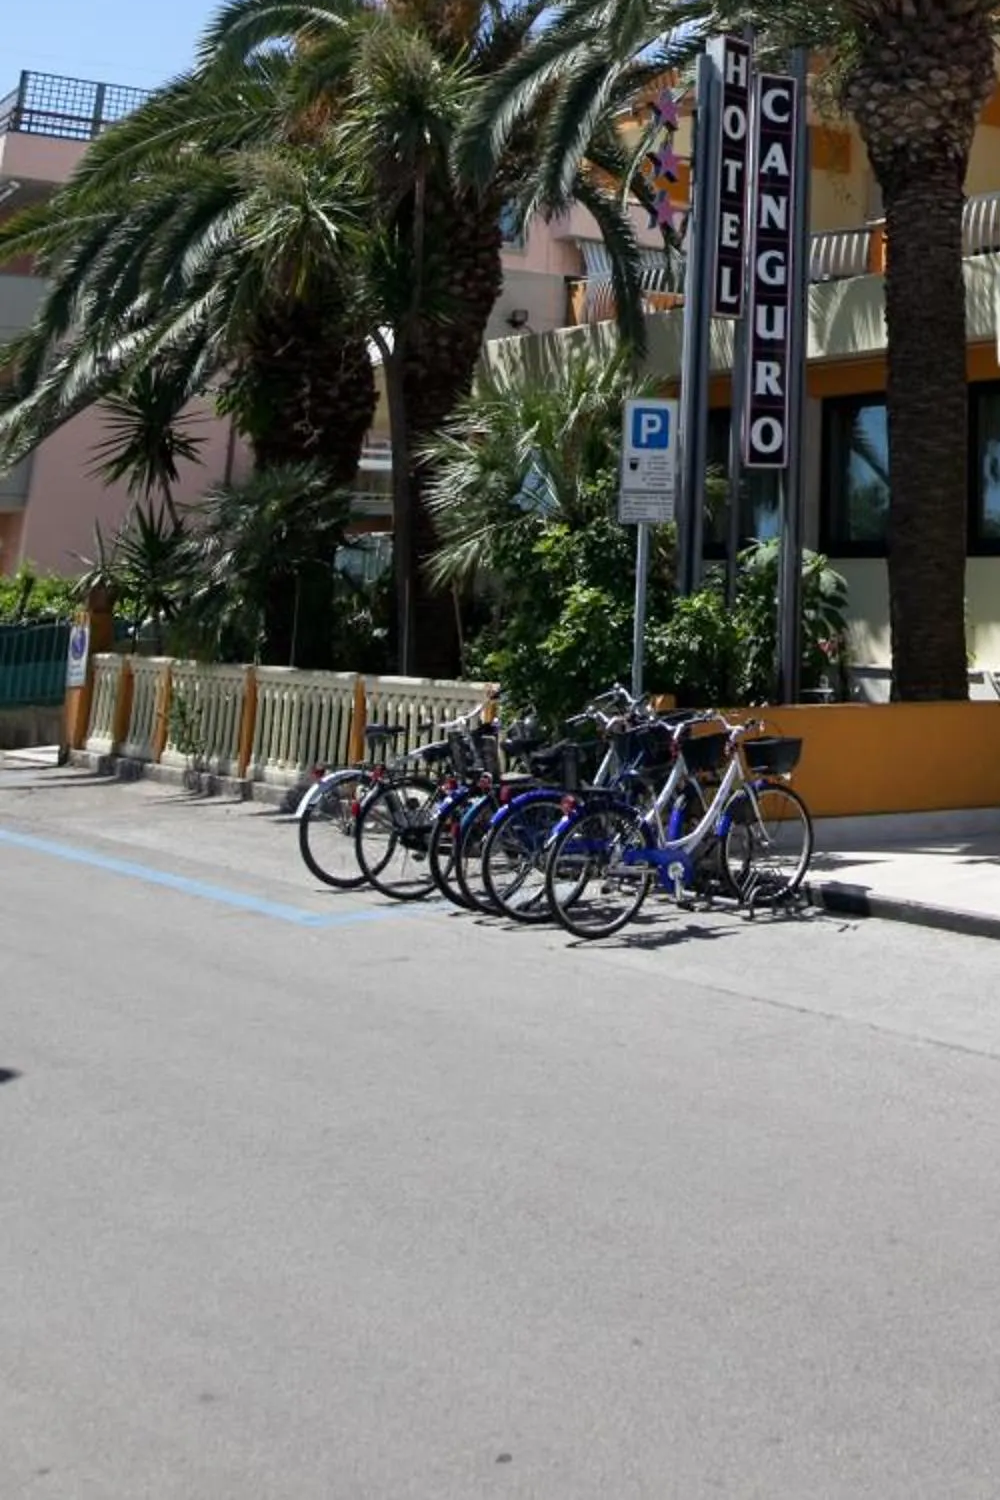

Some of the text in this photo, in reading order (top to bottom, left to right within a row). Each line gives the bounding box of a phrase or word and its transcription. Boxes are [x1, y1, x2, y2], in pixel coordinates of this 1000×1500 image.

[720, 51, 748, 305] HOTEL
[752, 88, 790, 454] CANGURO
[641, 413, 661, 443] P
